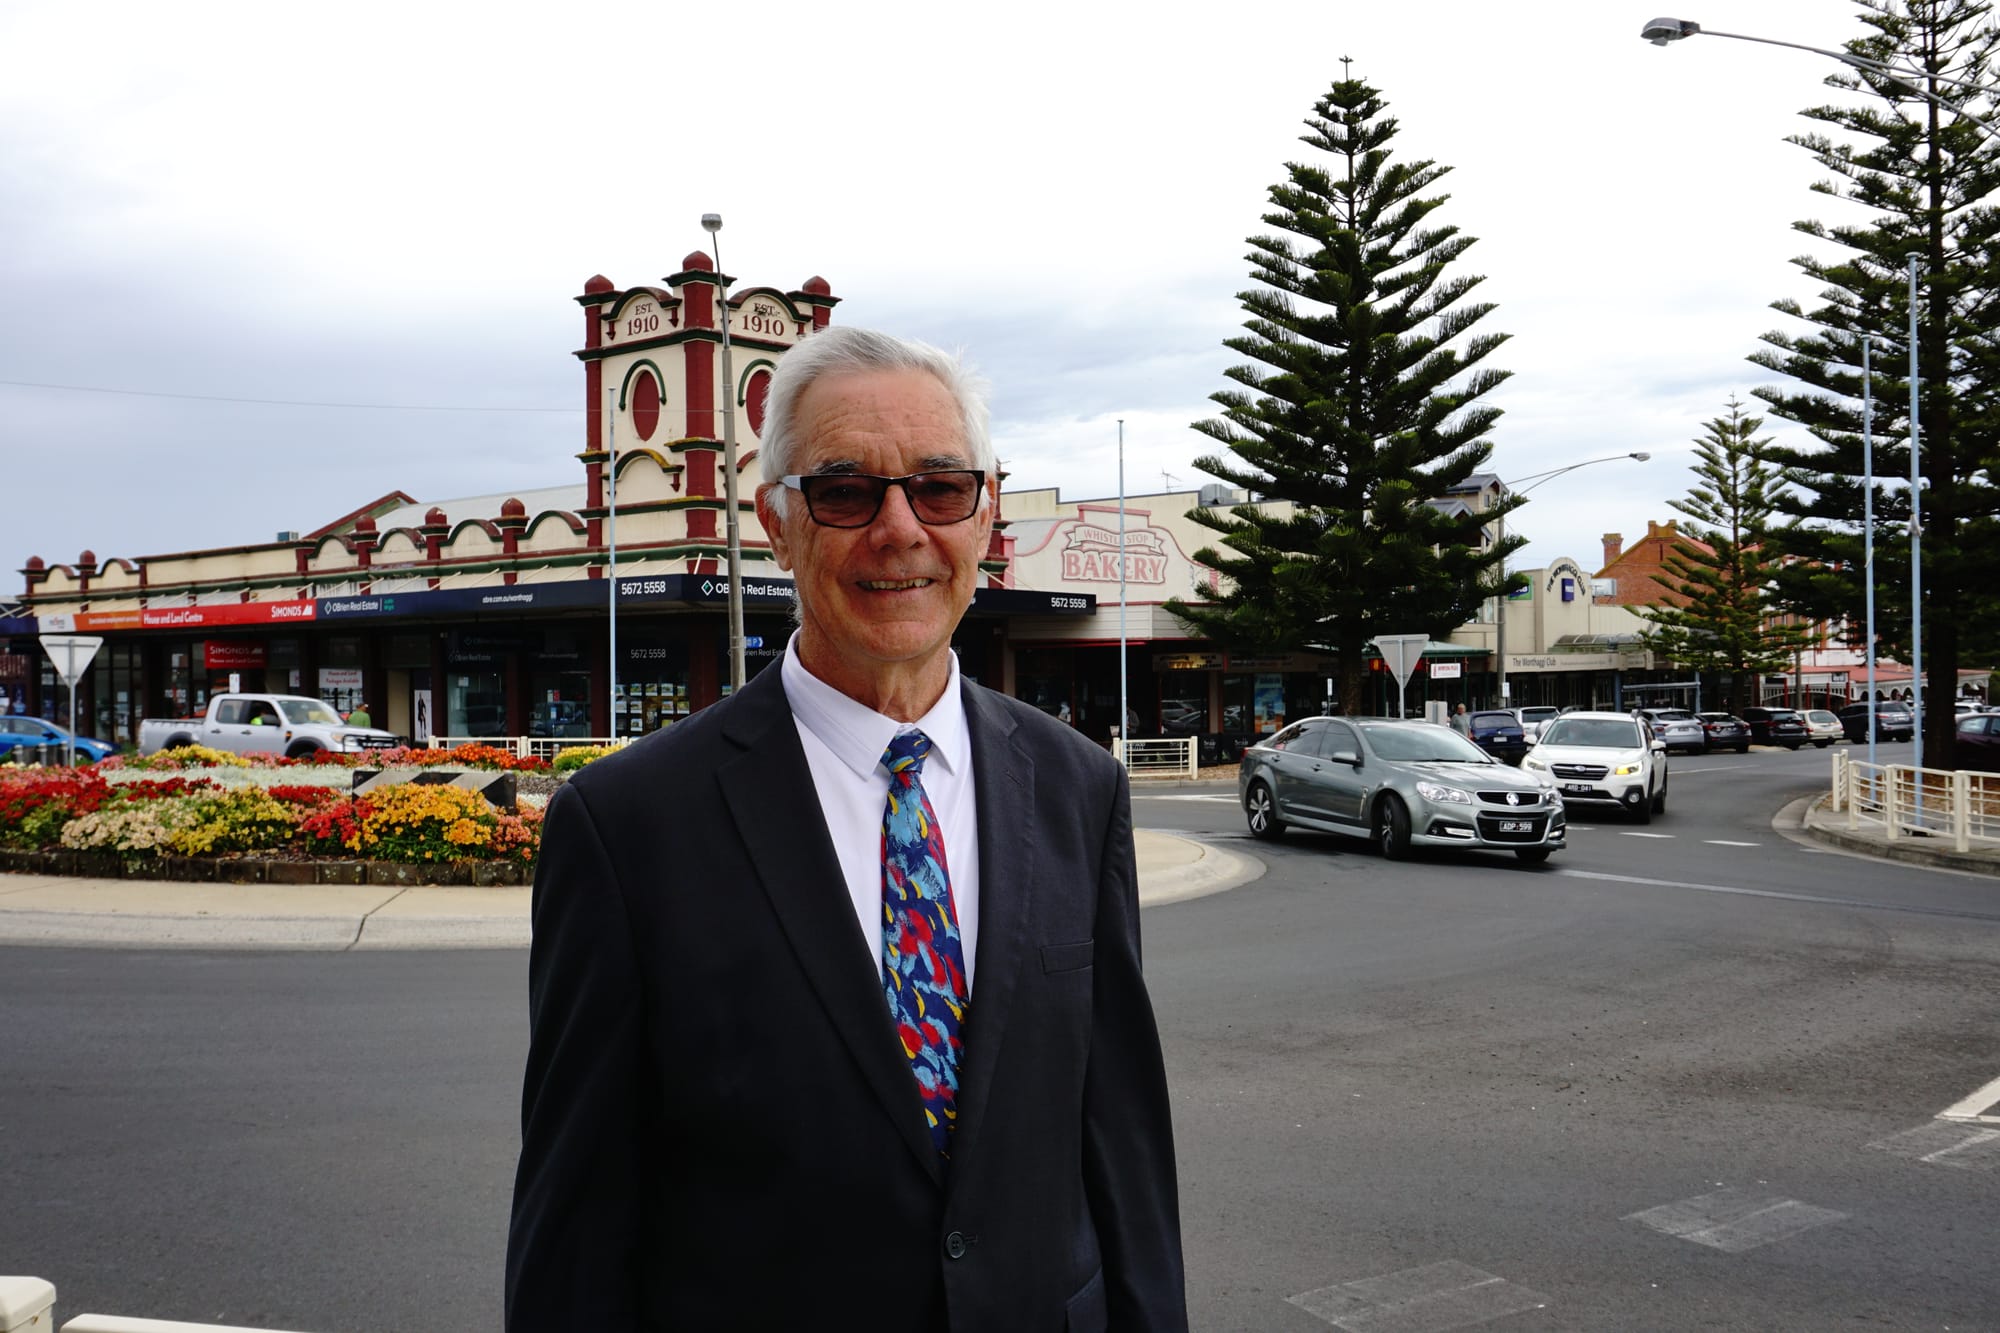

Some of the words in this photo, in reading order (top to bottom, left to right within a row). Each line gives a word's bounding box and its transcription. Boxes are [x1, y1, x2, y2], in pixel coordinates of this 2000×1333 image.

[628, 314, 659, 336] 1910
[742, 314, 784, 336] 1910
[1083, 529, 1120, 544] WHISTL
[1126, 533, 1149, 544] STOP
[1066, 552, 1162, 581] BAKERY
[621, 582, 642, 596] 5672
[644, 580, 666, 594] 5558
[746, 584, 766, 596] Real
[767, 585, 793, 597] Estate
[1051, 596, 1068, 608] 5672
[1069, 598, 1086, 609] 5558
[144, 613, 160, 624] House
[160, 614, 170, 624] and
[170, 612, 184, 624] Land
[184, 610, 204, 622] Centre
[272, 605, 302, 618] SIMONDS
[209, 645, 250, 655] SIMONDS
[630, 648, 647, 659] 5672
[648, 648, 666, 659] 5558
[1513, 658, 1522, 666] The
[1522, 658, 1545, 668] Wonthaggi
[1547, 657, 1556, 666] Club
